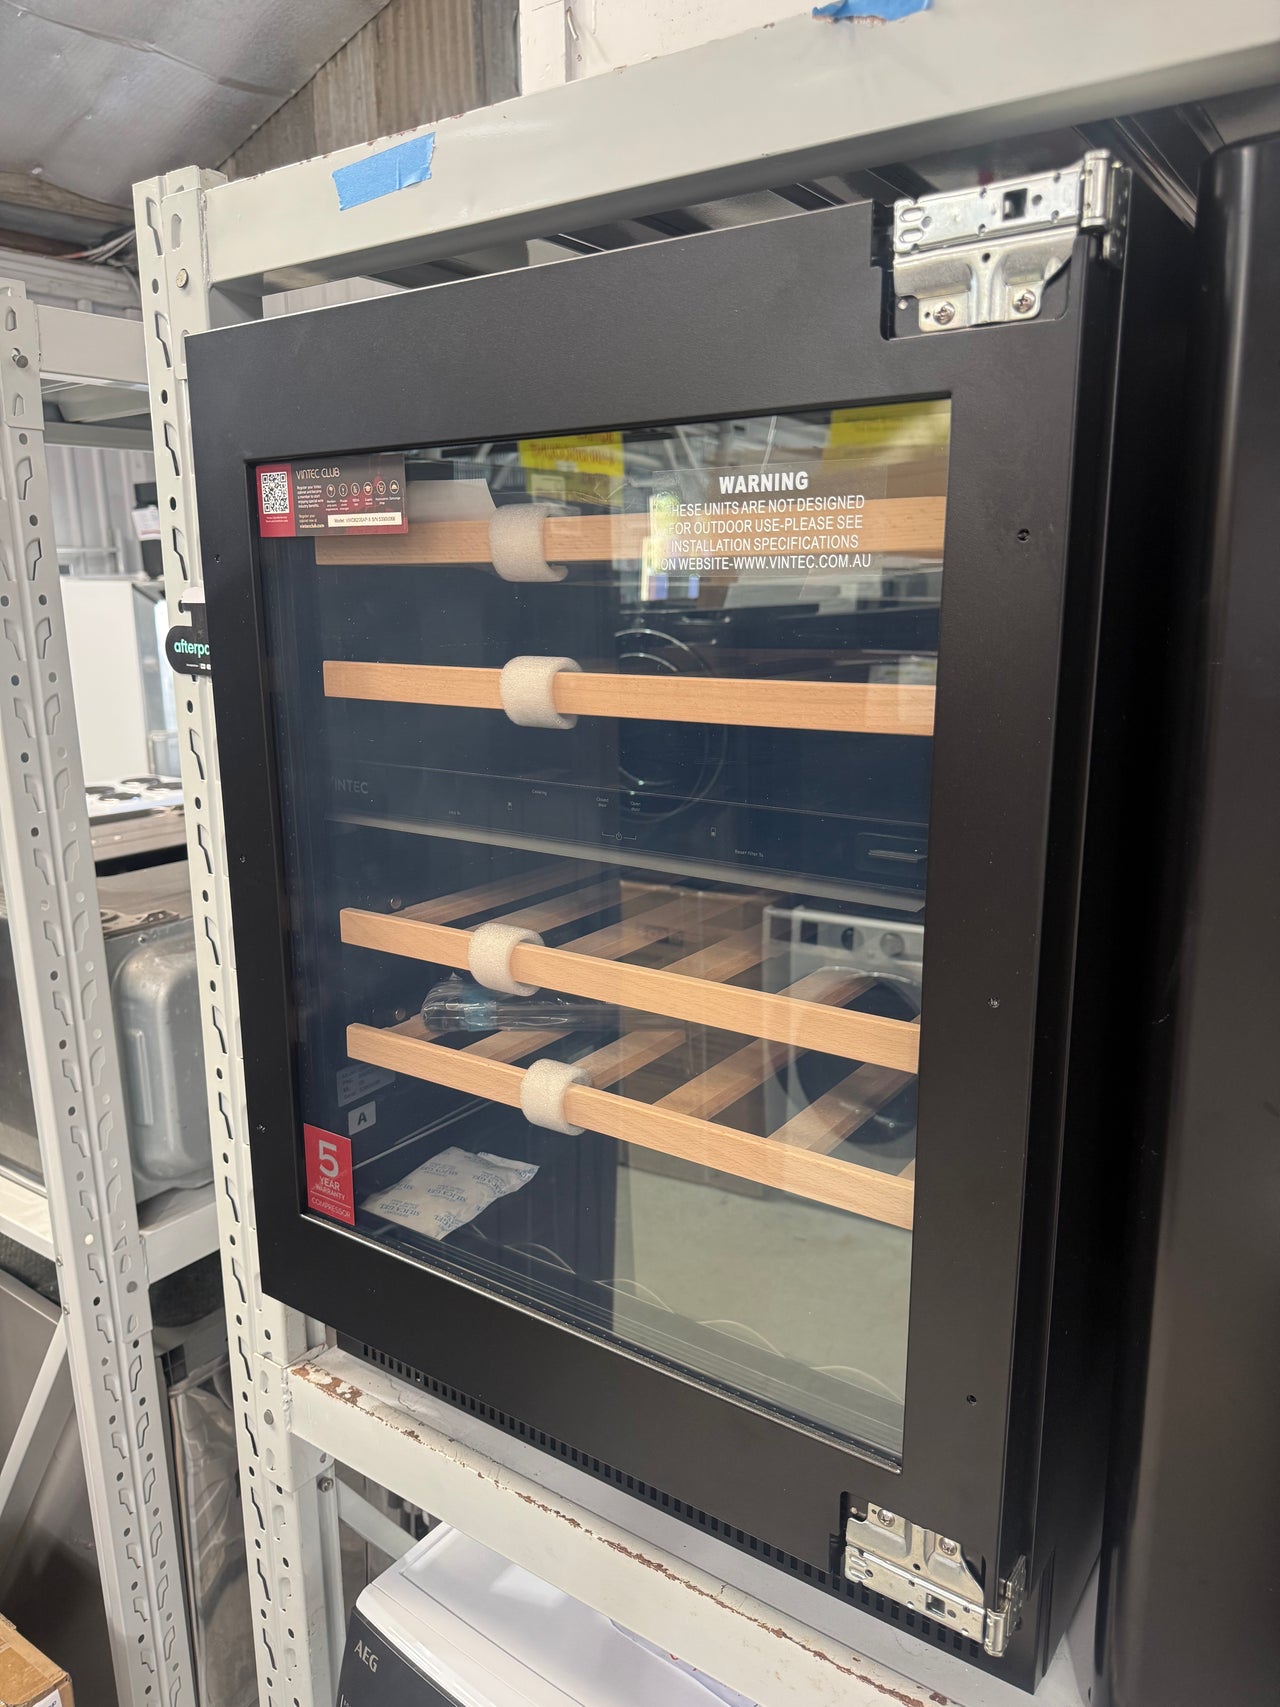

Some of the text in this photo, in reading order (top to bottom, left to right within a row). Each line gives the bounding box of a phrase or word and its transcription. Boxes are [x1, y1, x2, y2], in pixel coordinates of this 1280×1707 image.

[295, 467, 340, 480] VINTEC CLUB
[719, 471, 809, 494] WARNING
[704, 501, 740, 516] UNITS
[740, 500, 766, 514] ARE
[767, 498, 794, 513] NOT
[796, 495, 865, 511] DESIGNED
[668, 514, 864, 535] FOR OUTDOOR USE-PLEASE SEE
[671, 534, 859, 553] INSTALLATION SPECIFICATIONS
[660, 553, 871, 571] ON WEBSITE-WWW.VINTEC.COM.AU
[357, 1111, 367, 1126] A
[318, 1139, 339, 1178] 5
[314, 1183, 345, 1201] WARRANTY
[319, 1176, 341, 1191] YEAR
[311, 1196, 351, 1218] COMPRESSOR
[354, 1639, 379, 1673] AEG
